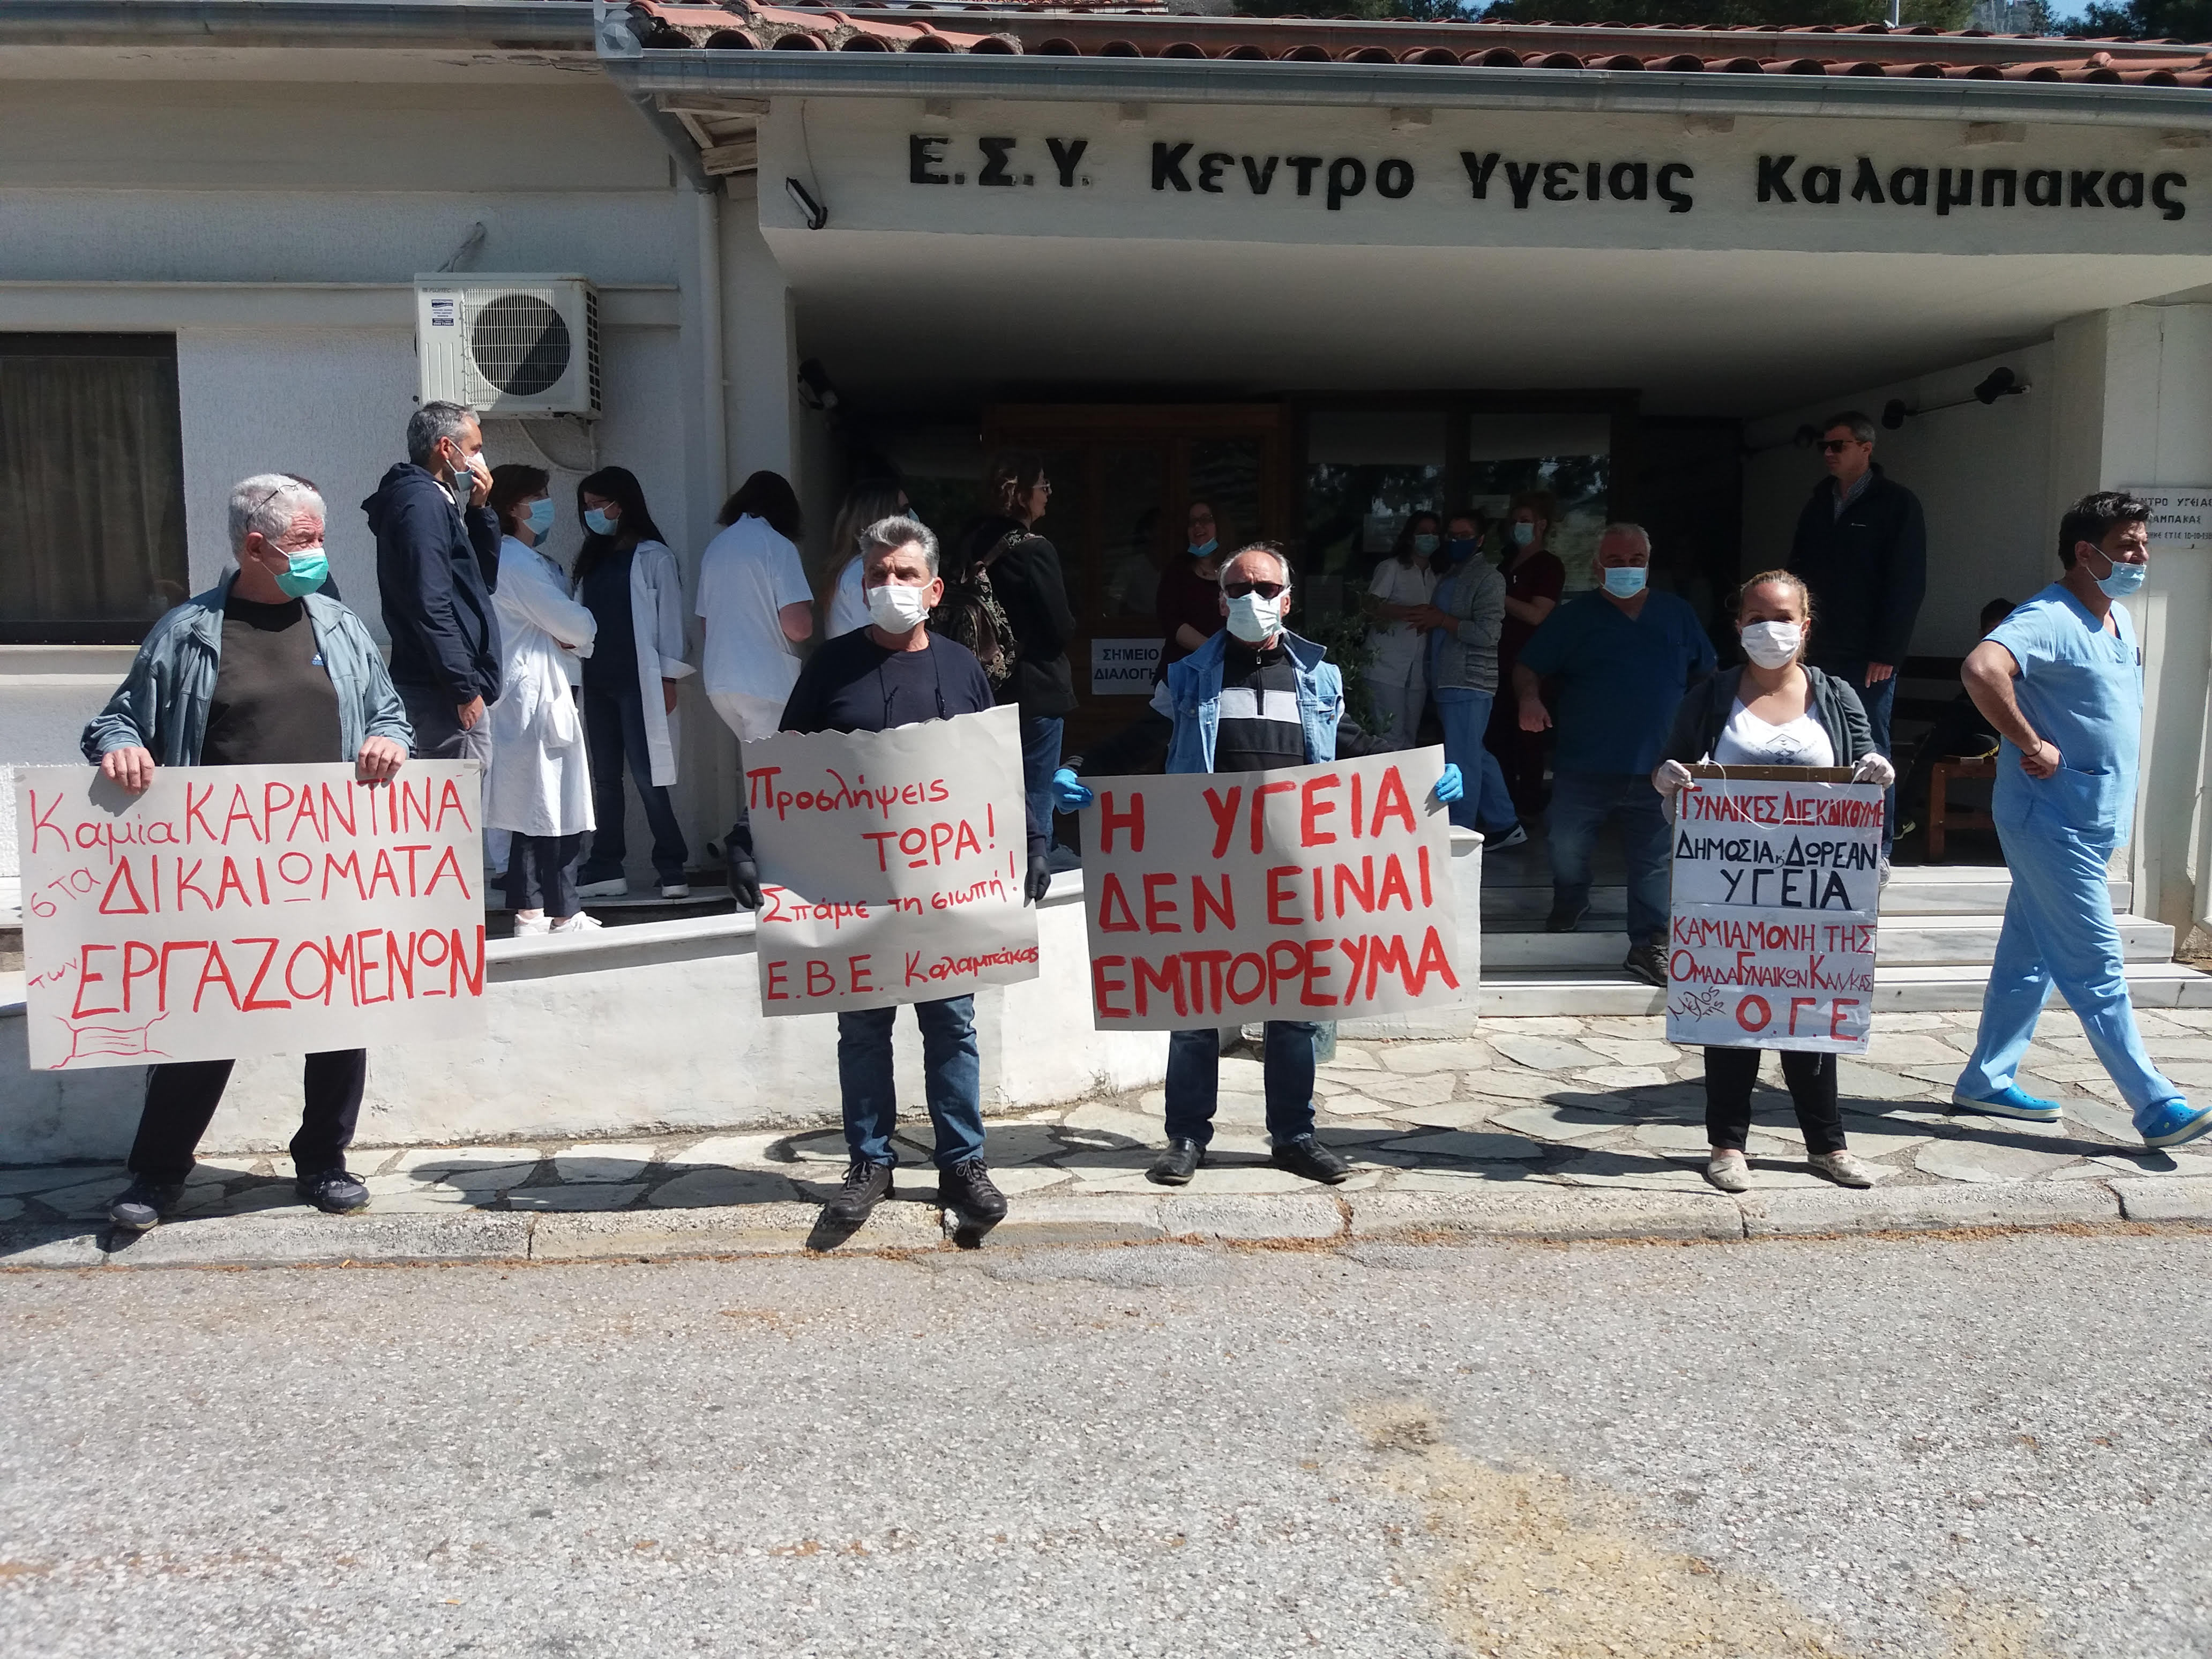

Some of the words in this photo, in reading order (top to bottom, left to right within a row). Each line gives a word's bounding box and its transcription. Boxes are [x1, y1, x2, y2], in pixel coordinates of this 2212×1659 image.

[1152, 141, 1415, 211] Κεντρο
[1460, 151, 1694, 213] Υγειας
[1756, 154, 2187, 220] Καλαμπακας
[2154, 515, 2201, 524] ΑΜΠΑΚΑΣ
[1103, 648, 1159, 661] ΣΗΜΕΙΟ
[186, 776, 472, 845] ΚΑΡΑΝΤΙΝΑ
[746, 766, 950, 821] Προσλήψεις
[1100, 791, 1145, 854] Η
[1202, 765, 1416, 859] ΥΓΕΙΑ
[1682, 786, 1781, 824] ΓΥΝΑΙΚΕΣ
[1675, 829, 1775, 864] ΔΗΜΟΣΙΑ
[1785, 834, 1878, 871] ΔΩΡΕΑΝ
[99, 845, 471, 915] ΔΙΚΑΙΩΜΑΤΑ
[1098, 872, 1236, 934] ΔΕΝ
[1266, 845, 1433, 926] ΕΙΝΑΙ
[1720, 868, 1853, 910] ΥΓΕΙΑ
[760, 886, 870, 930] Σπάμε
[887, 897, 923, 915] τη
[1824, 925, 1875, 954] ΤΗΣ
[72, 924, 485, 1019] ΕΡΓΑΖΟΜΕΝΩΝ
[1092, 925, 1461, 1018] ΕΜΠΟΡΕΥΜΑ
